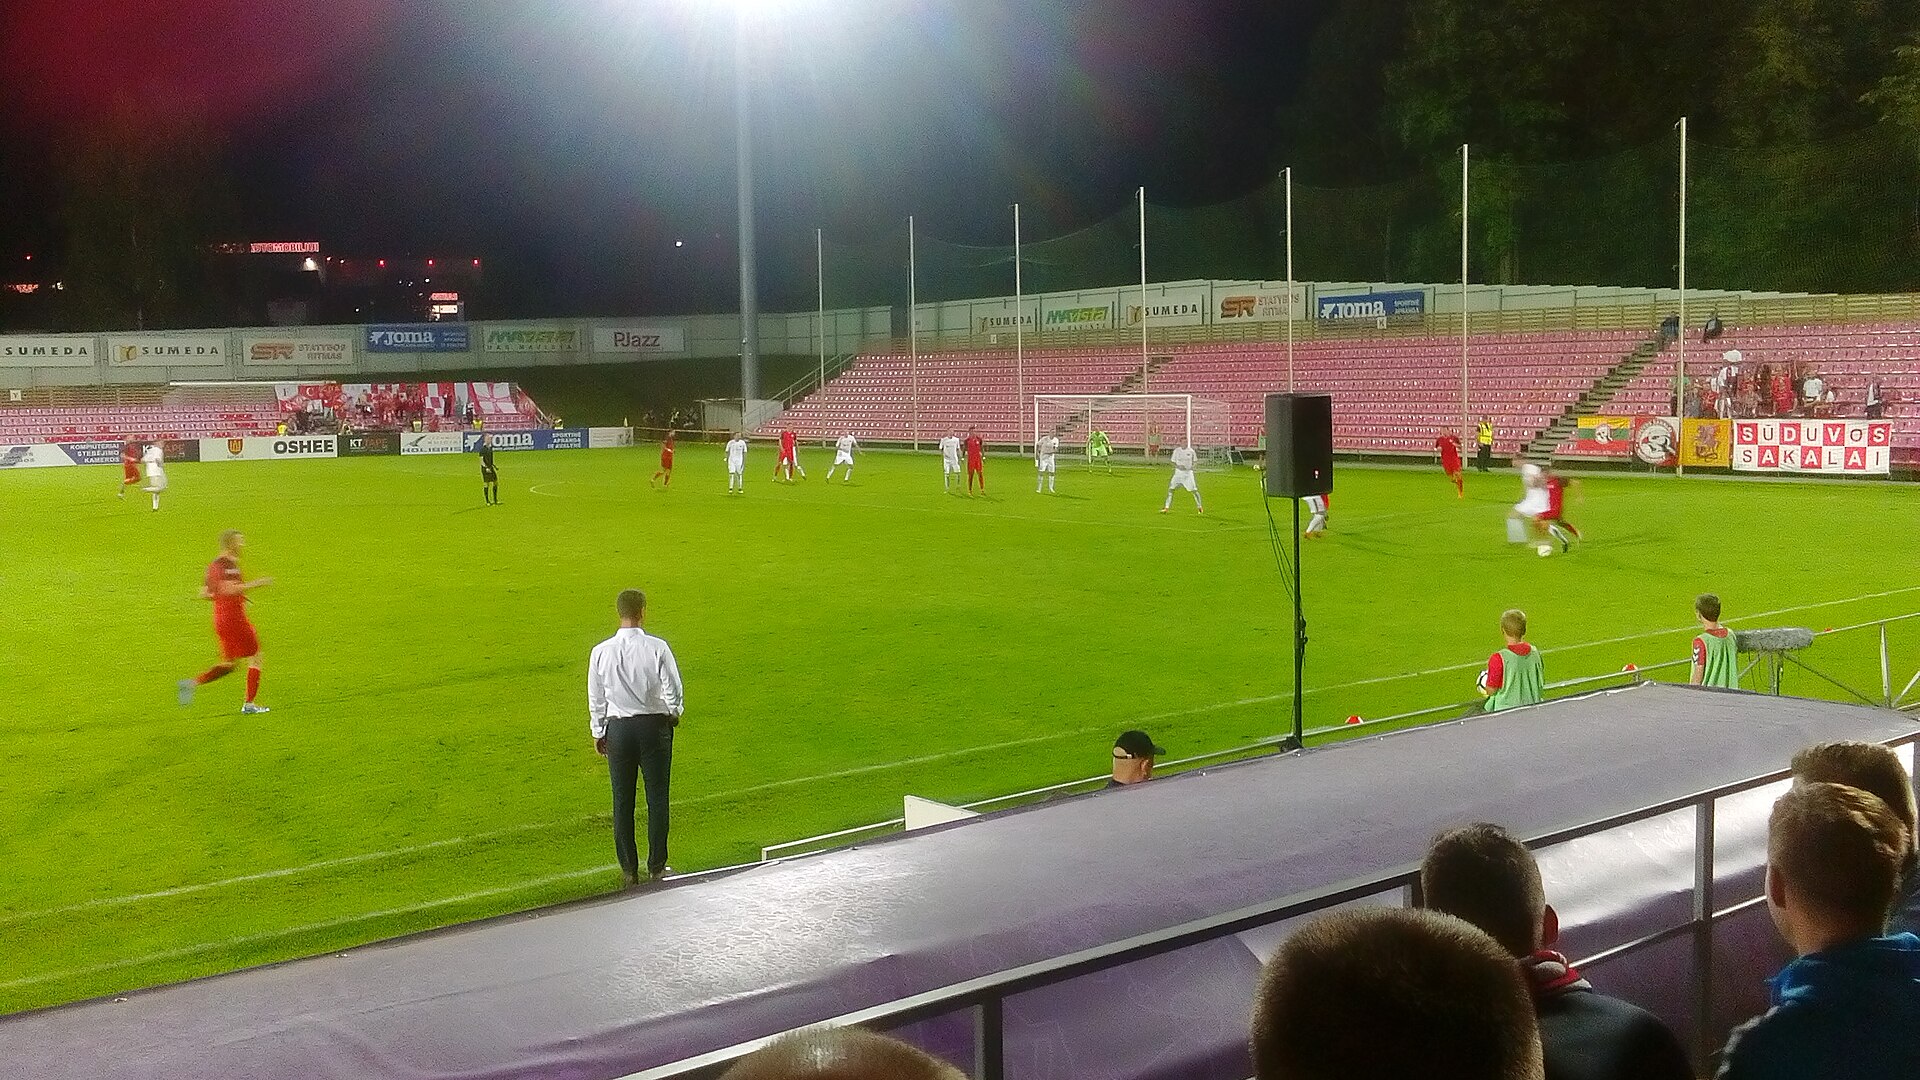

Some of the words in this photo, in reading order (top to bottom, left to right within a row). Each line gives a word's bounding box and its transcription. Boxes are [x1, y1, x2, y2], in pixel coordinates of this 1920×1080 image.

[1144, 303, 1198, 317] SUMEDA
[989, 315, 1032, 326] SUMEDA
[5, 346, 88, 355] SUMEDA
[141, 345, 220, 355] SUMEDA
[1741, 424, 1886, 443] SŪDUVOS
[273, 439, 334, 454] OSHEE
[1742, 448, 1880, 467] SAKALAI
